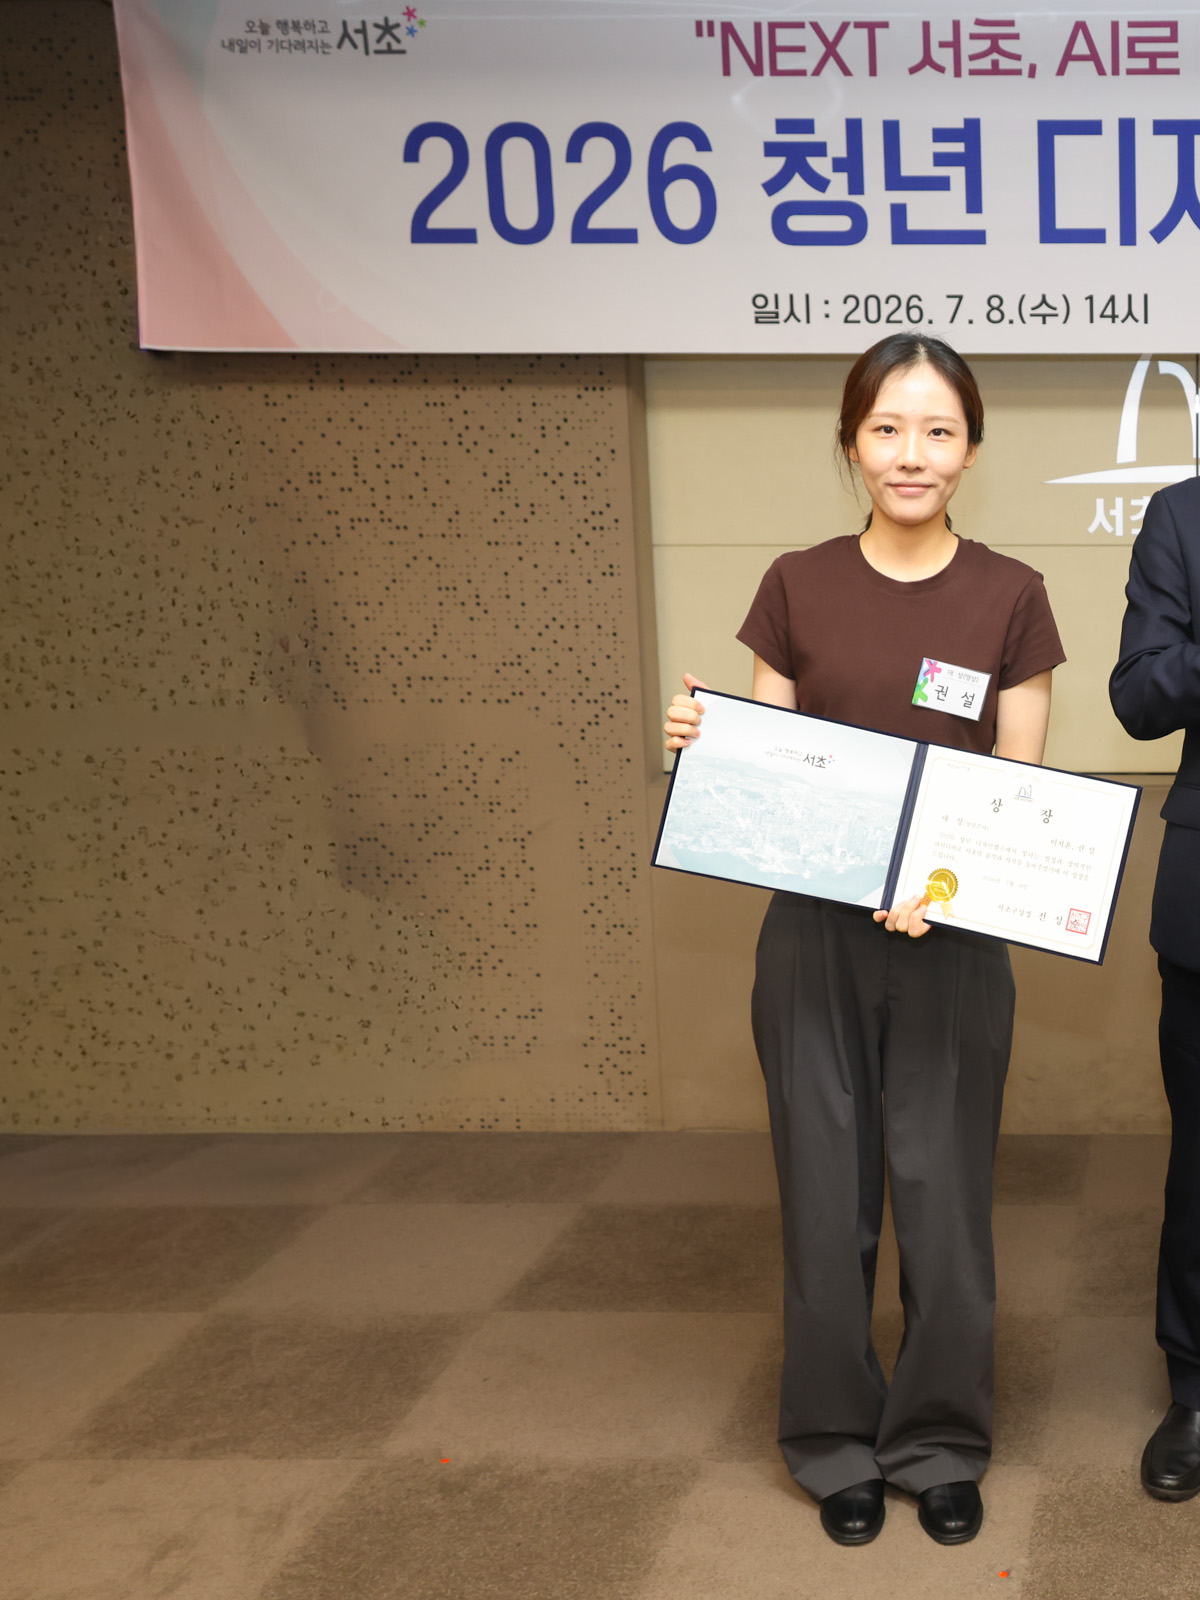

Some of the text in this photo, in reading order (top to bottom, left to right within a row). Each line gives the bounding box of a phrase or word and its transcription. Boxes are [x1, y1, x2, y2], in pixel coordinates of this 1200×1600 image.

[244, 19, 330, 36] 오늘 행복하고
[336, 16, 407, 56] 서초
[220, 38, 333, 55] 내일이 기다려지는
[695, 20, 889, 77] "NEXT
[908, 18, 1037, 79] 서초,
[1055, 20, 1180, 77] AI로
[403, 121, 718, 246] 2026
[761, 117, 987, 247] 청년
[751, 293, 811, 325] 일시
[842, 294, 933, 325] 2026.
[946, 294, 974, 325] 7.
[986, 293, 1070, 325] 8.(수)
[1084, 293, 1149, 325] 14시
[934, 684, 976, 709] 권 설
[802, 752, 827, 769] 서초
[990, 797, 1004, 814] 상
[1039, 808, 1054, 825] 장
